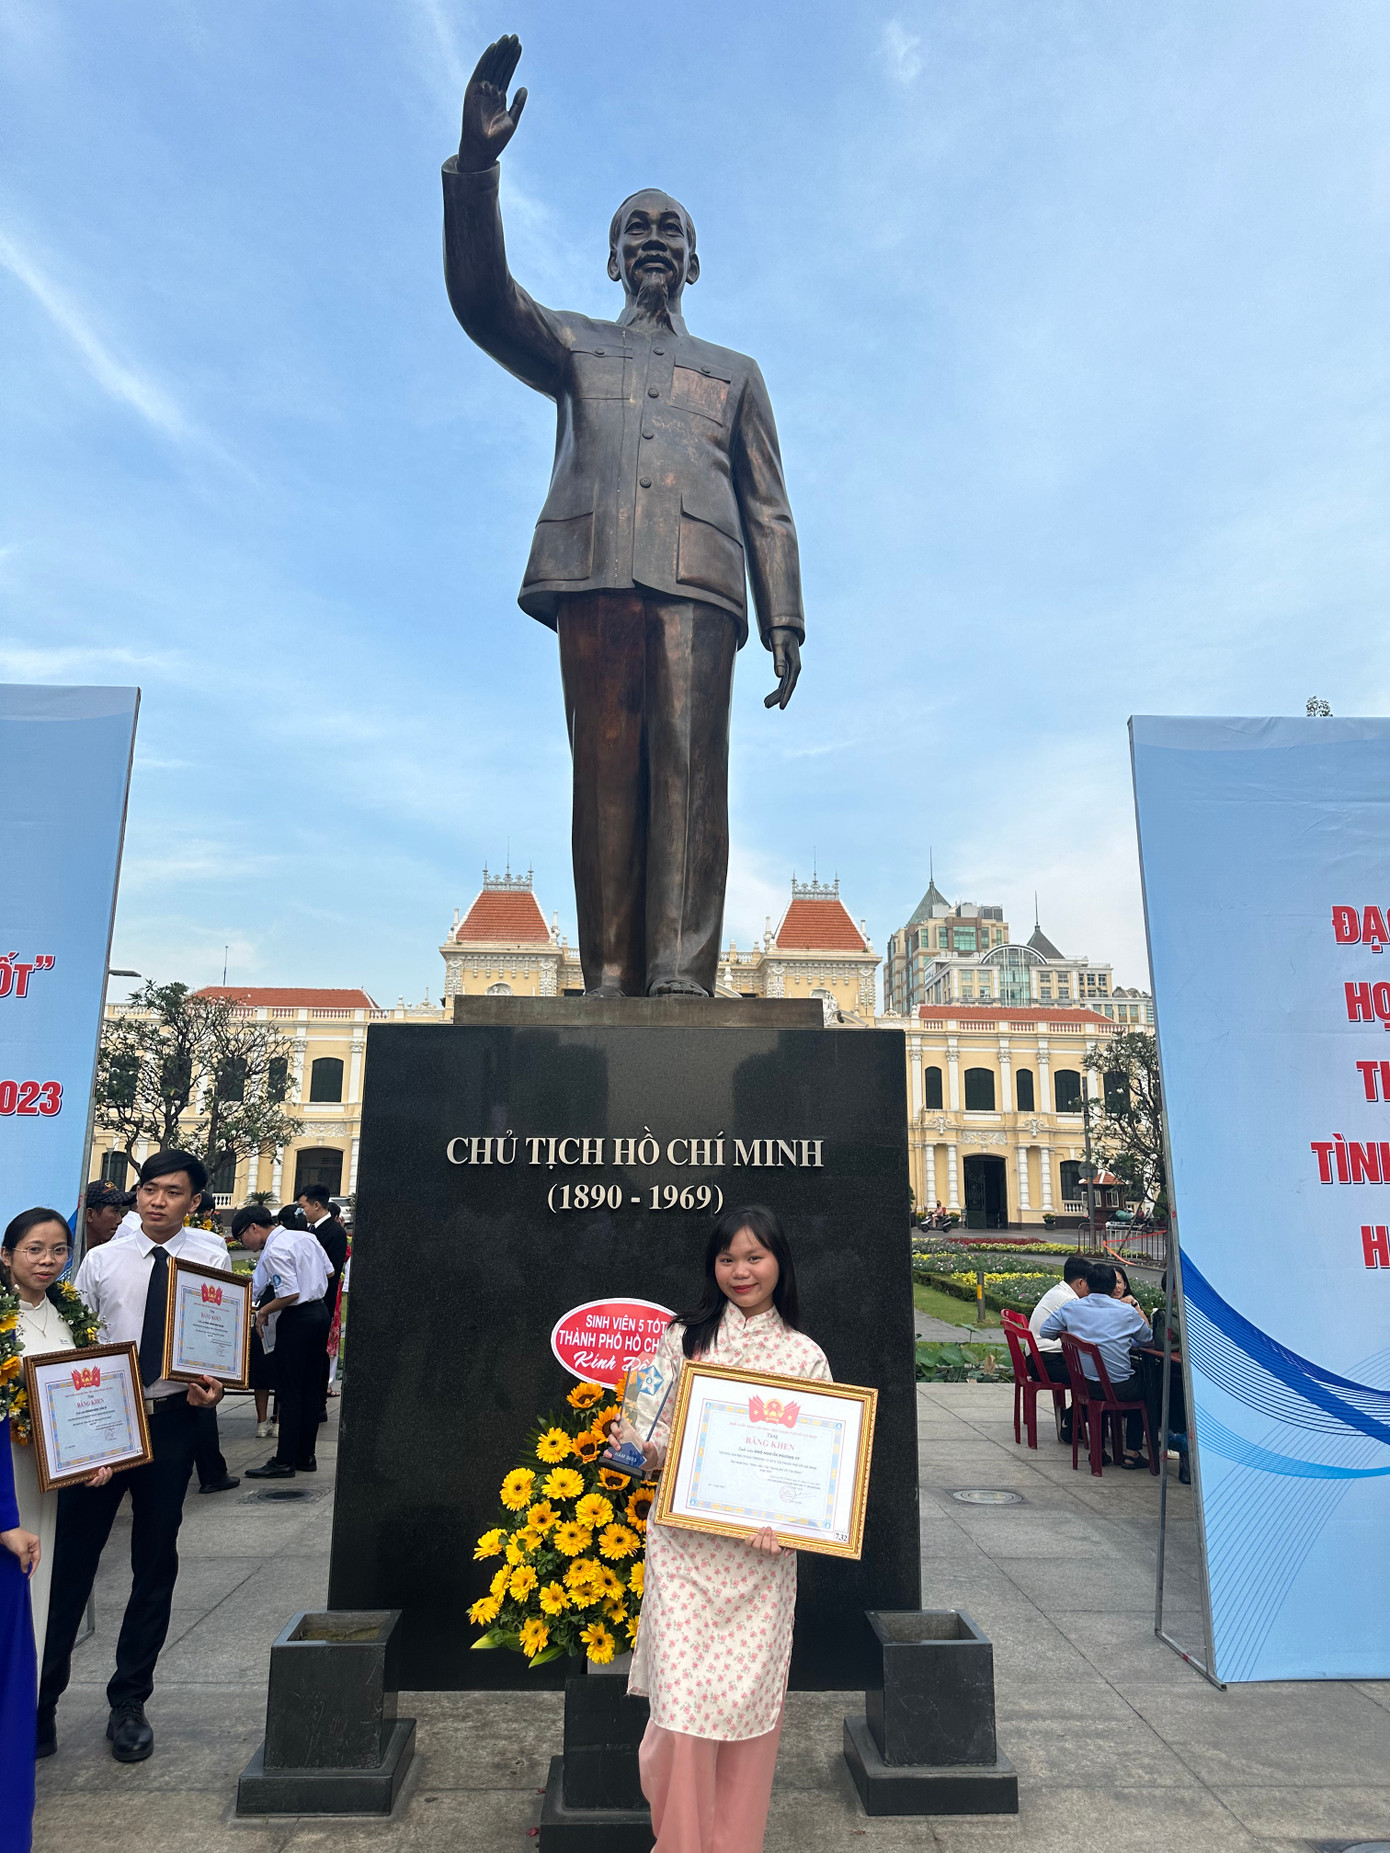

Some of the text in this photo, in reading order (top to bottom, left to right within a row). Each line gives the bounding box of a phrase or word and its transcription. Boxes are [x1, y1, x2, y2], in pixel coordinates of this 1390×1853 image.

[1331, 905, 1390, 952] ĐẠ
[446, 1126, 824, 1170] CHỦ TỊCH HỒ CHÍ MINH
[547, 1183, 623, 1213] (1890
[649, 1184, 725, 1214] 1969)
[586, 1314, 610, 1329] SINH
[612, 1314, 636, 1331] VIÊN
[638, 1319, 645, 1332] 5
[559, 1327, 660, 1353] THÀNH PHỐ HỒ CH
[573, 1351, 617, 1371] Kính
[771, 1441, 795, 1451] KHEN
